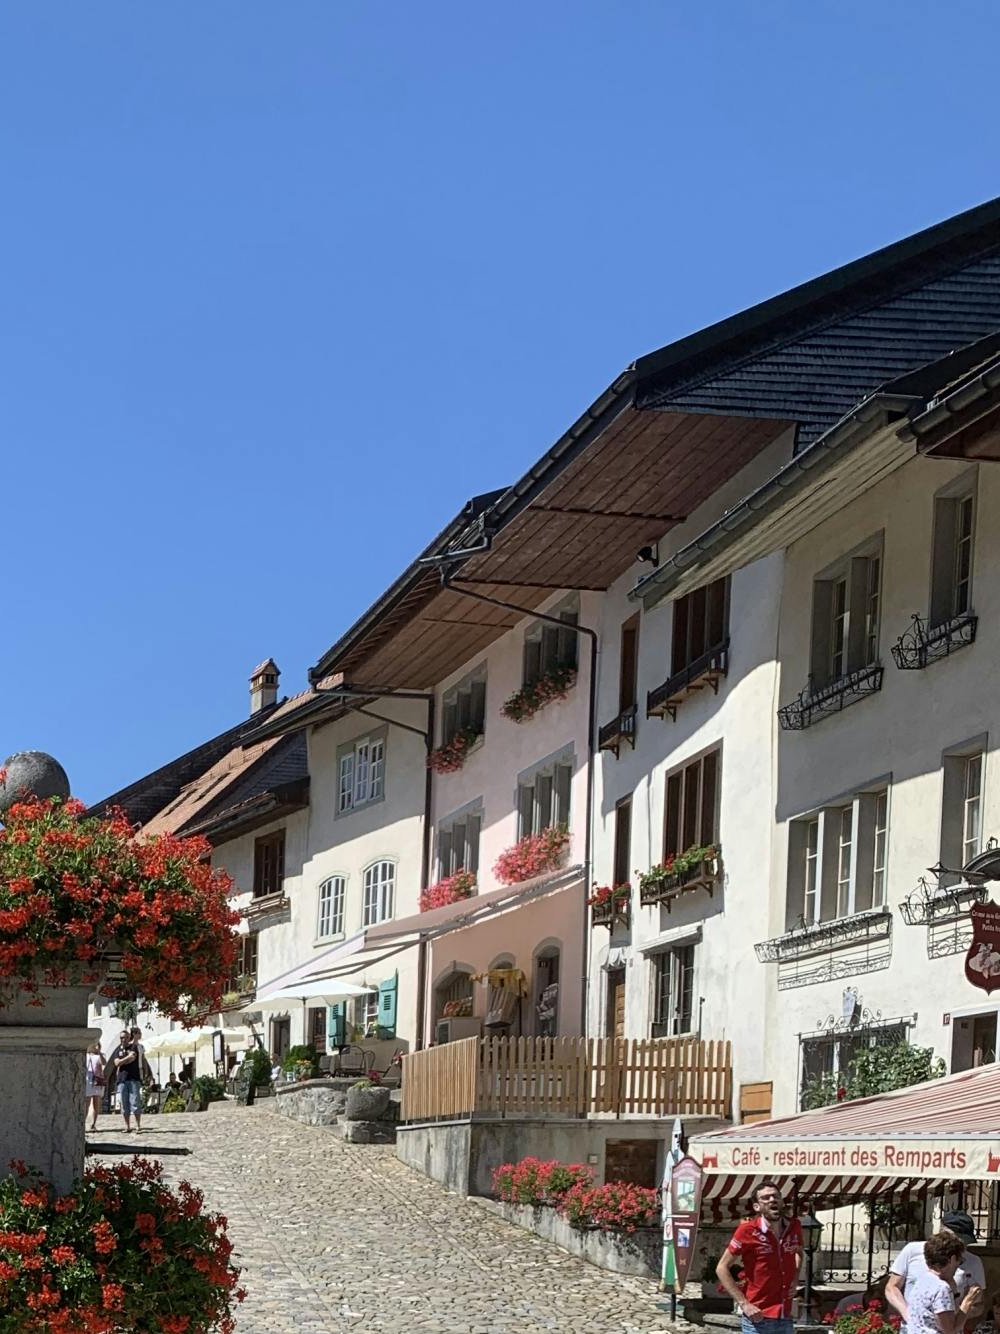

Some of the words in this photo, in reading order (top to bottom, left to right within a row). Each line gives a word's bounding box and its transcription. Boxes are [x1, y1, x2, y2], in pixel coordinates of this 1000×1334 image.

[732, 1147, 760, 1166] Café
[773, 1147, 846, 1166] restaurant
[850, 1145, 878, 1166] des
[884, 1145, 966, 1173] Remparts
